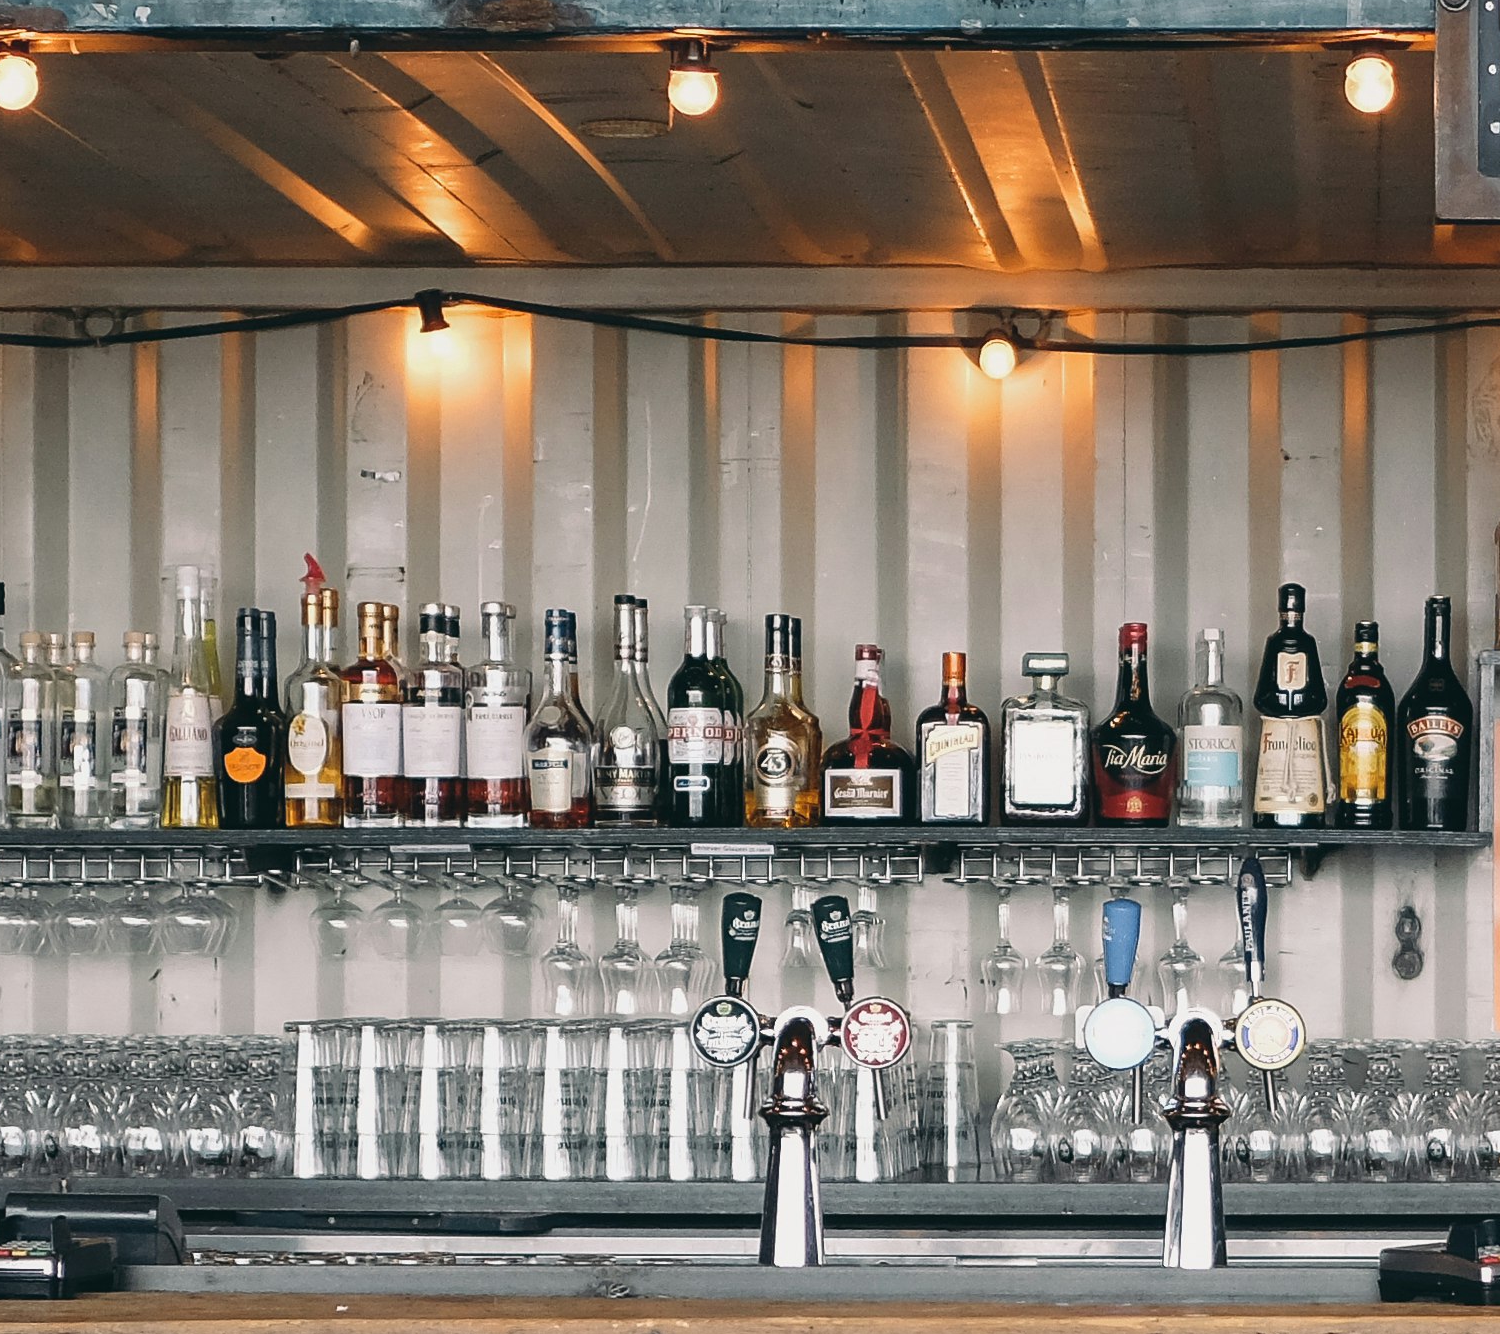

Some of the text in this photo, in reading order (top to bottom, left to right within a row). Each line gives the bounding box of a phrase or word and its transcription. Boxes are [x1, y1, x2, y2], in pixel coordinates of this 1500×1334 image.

[1410, 718, 1461, 735] BAILEYS
[1187, 737, 1237, 751] STORICA
[1262, 732, 1318, 755] Franelico
[1101, 743, 1169, 770] Tia Maria
